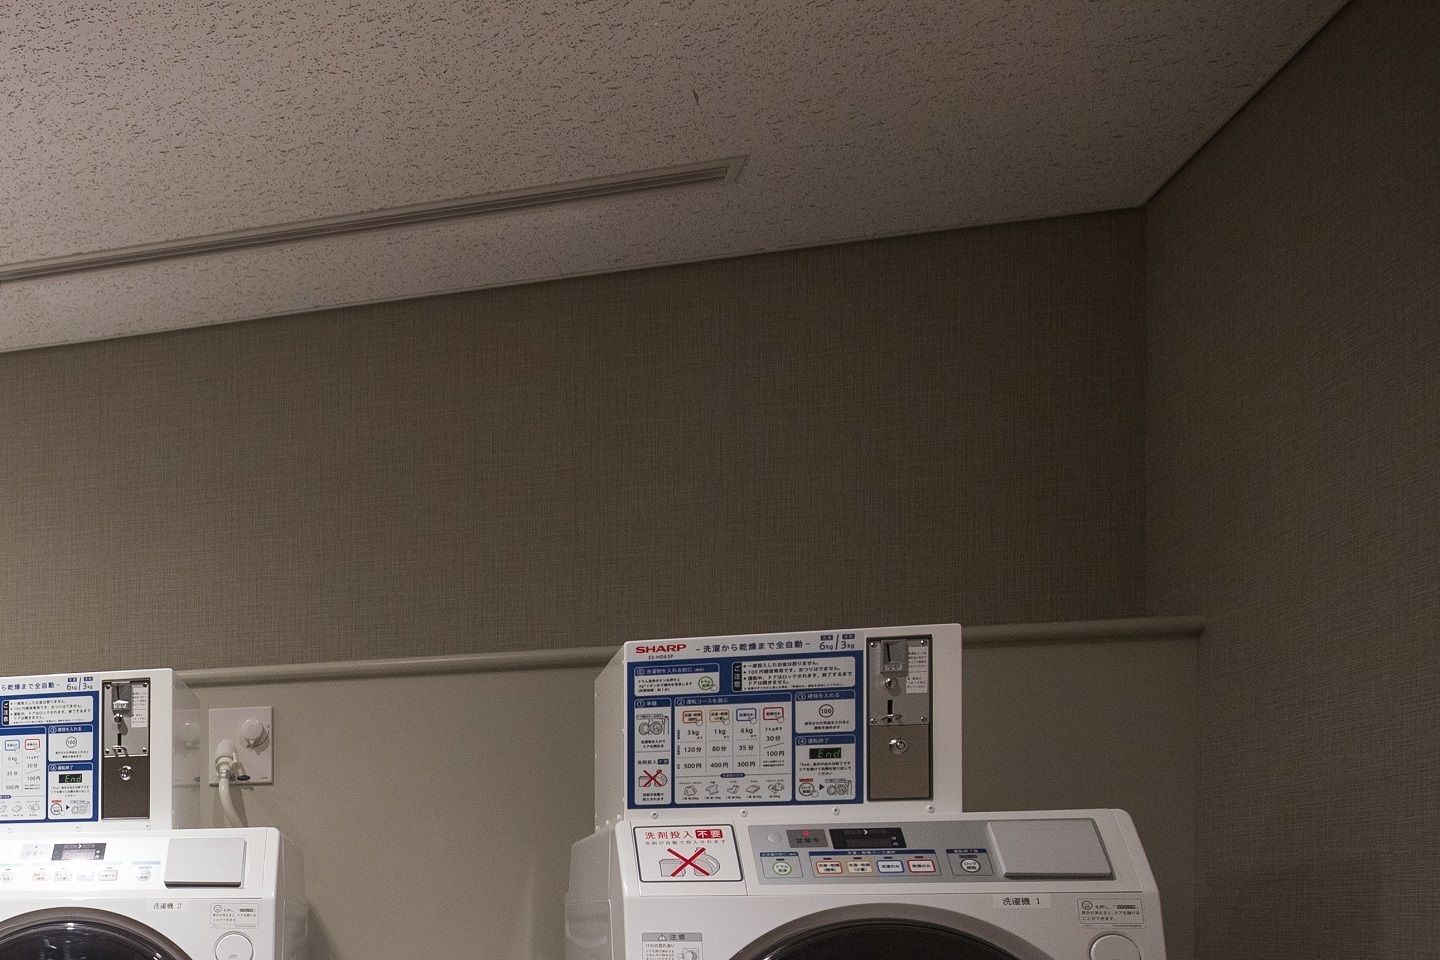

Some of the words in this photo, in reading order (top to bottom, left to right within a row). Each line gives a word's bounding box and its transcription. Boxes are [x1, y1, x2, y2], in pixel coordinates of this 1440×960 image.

[635, 644, 687, 654] SHARP
[703, 640, 803, 653] 洗濯から乾燥まで全自動
[819, 642, 834, 651] 6kg
[841, 640, 855, 650] 3kg
[817, 749, 840, 758] End
[64, 774, 82, 783] End
[645, 830, 693, 839] 洗剤投入
[697, 830, 722, 838] 不要
[153, 902, 174, 910] 洗濯機
[1002, 897, 1030, 906] 洗濯機
